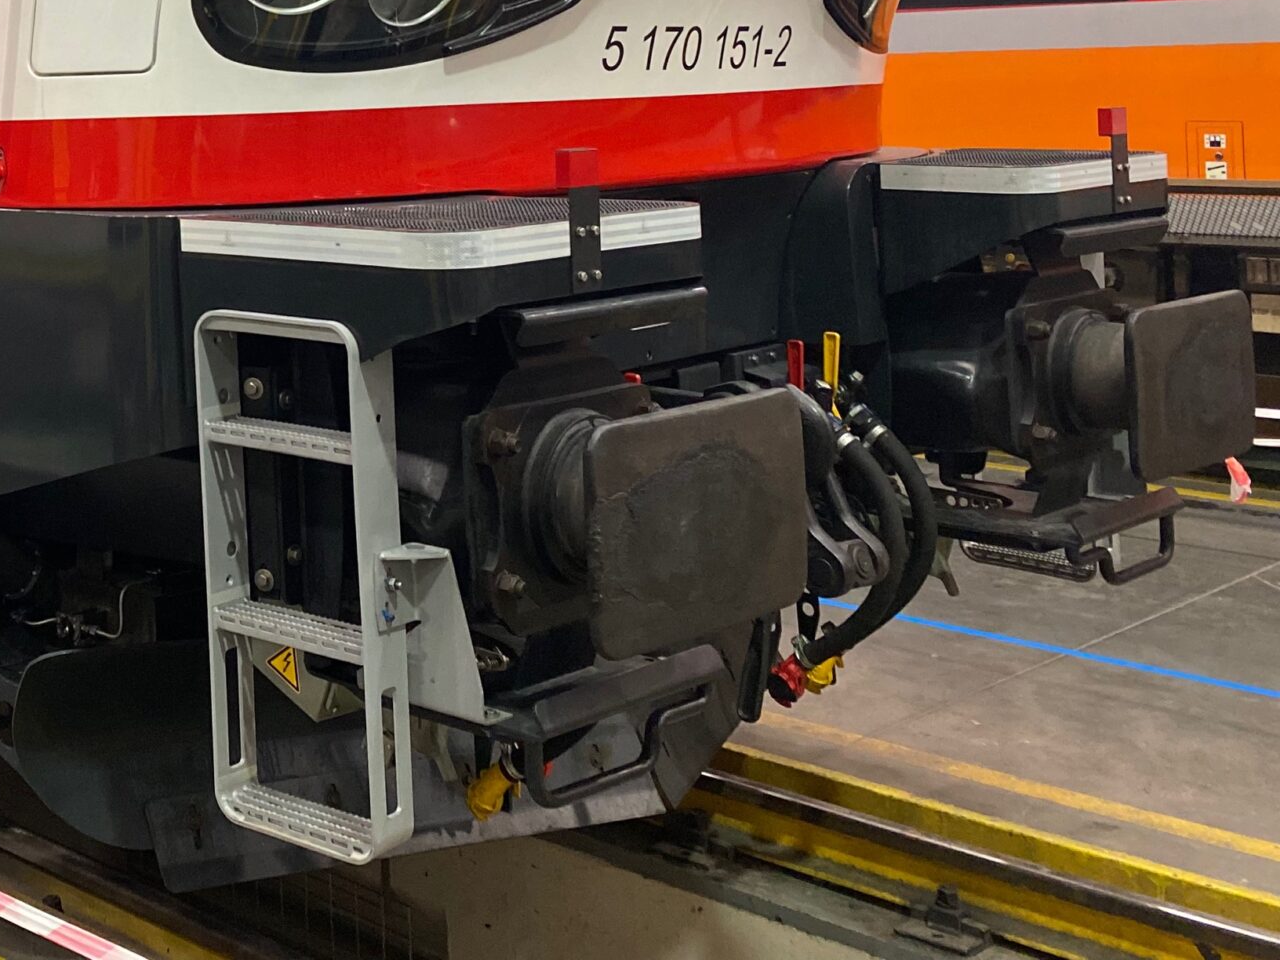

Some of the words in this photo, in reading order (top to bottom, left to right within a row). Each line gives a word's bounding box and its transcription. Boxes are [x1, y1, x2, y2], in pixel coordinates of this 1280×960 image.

[601, 25, 628, 72] 5
[642, 25, 702, 71] 170
[715, 24, 793, 70] 151-2
